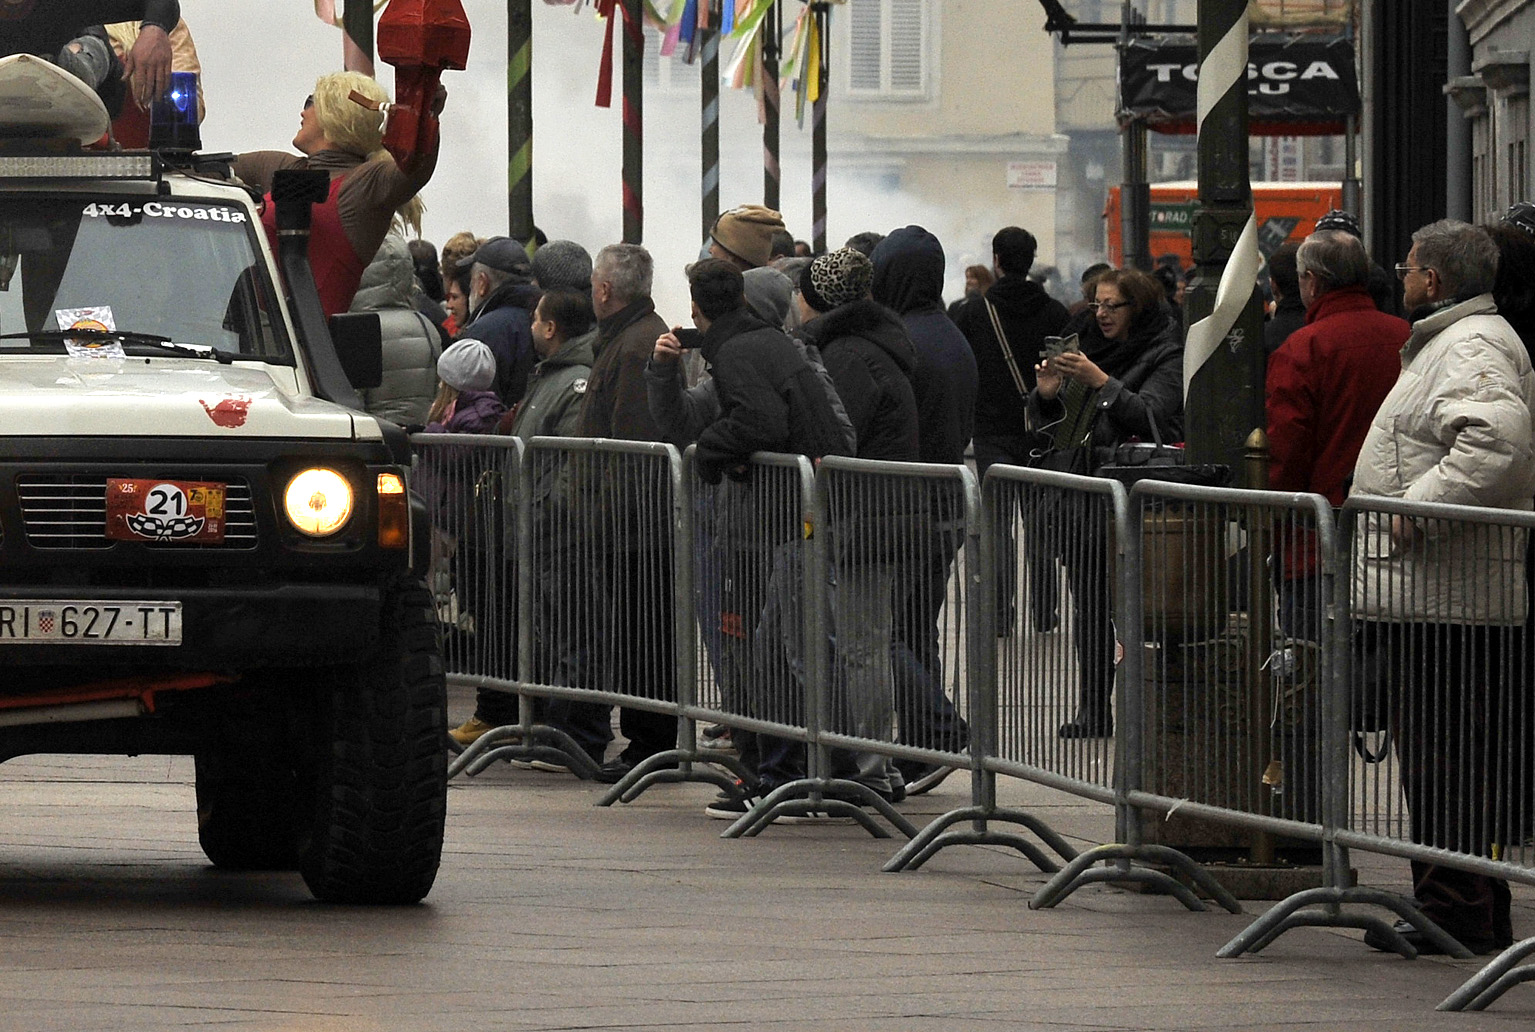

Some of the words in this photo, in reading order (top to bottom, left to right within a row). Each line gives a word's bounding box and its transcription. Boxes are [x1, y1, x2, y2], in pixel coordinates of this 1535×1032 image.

[82, 202, 247, 224] 4x4-Croatia
[149, 490, 183, 516] 21
[61, 606, 176, 639] 627-TT
